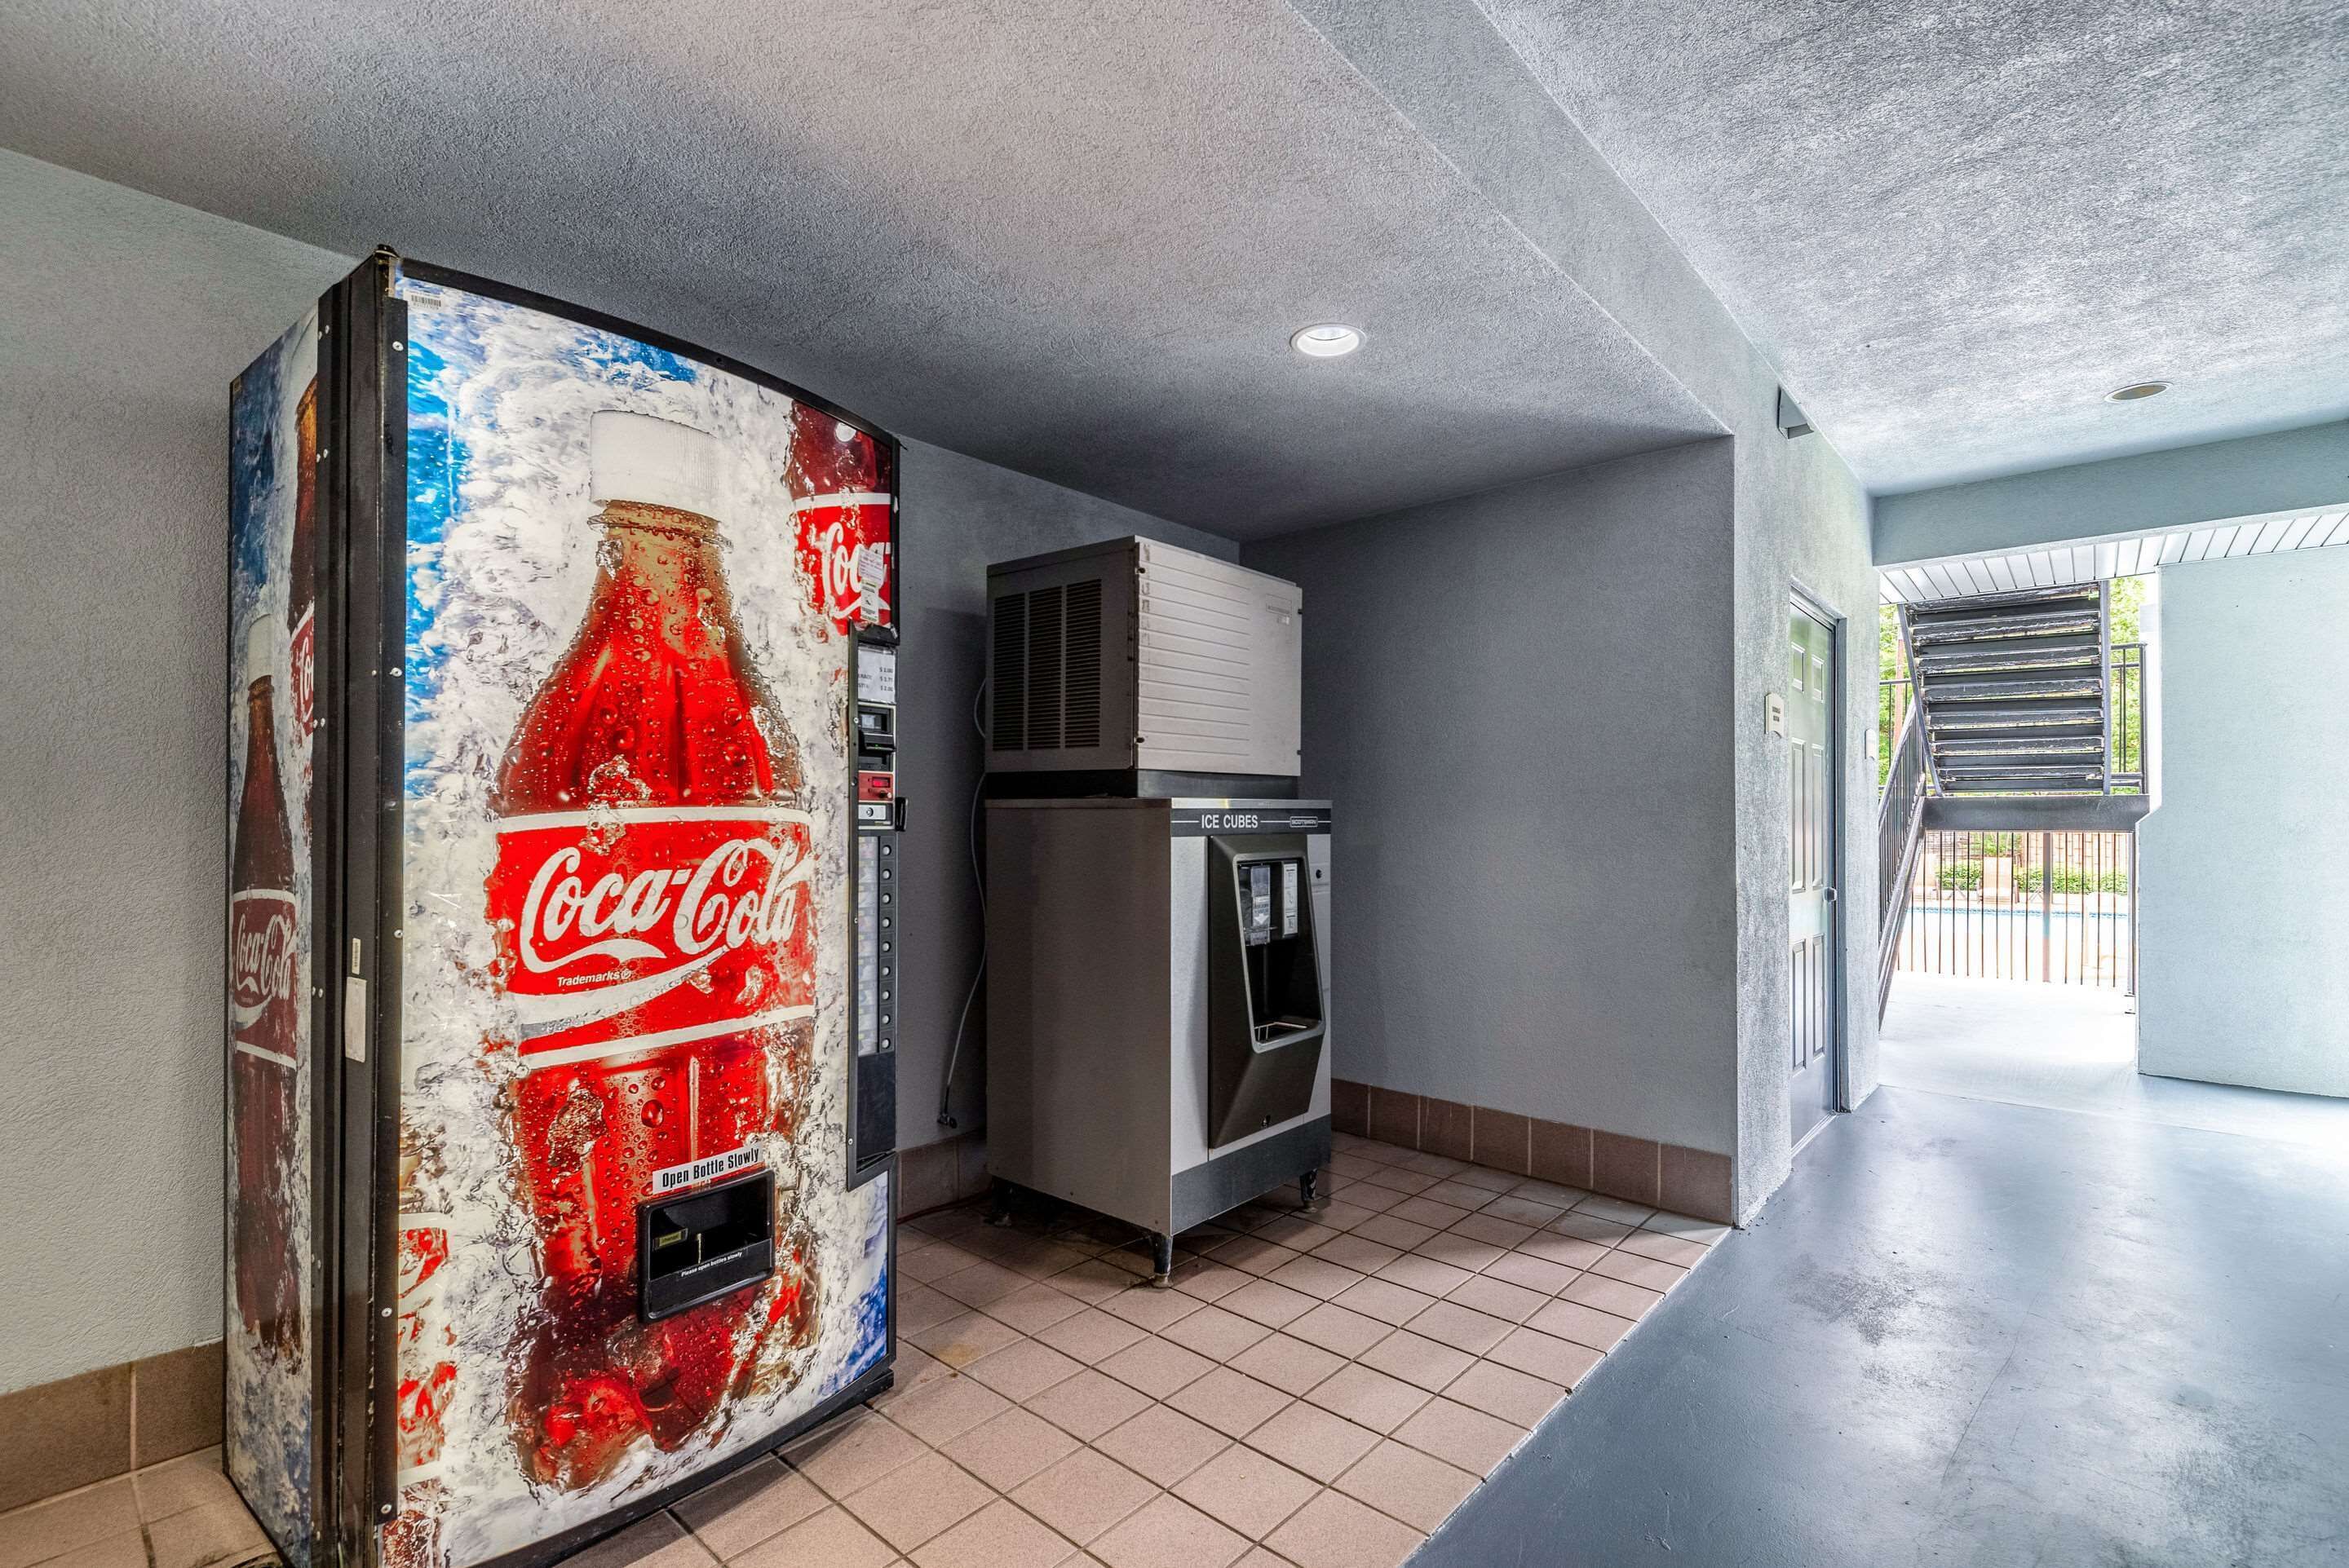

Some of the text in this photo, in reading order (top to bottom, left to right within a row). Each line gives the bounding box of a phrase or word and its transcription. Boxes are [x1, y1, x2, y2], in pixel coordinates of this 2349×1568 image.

[1201, 814, 1259, 829] ICE CUBES
[520, 838, 816, 972] Coca-Cola
[236, 913, 297, 1000] Coca-Cola
[662, 1147, 759, 1188] Open Bottle Slowly
[681, 1267, 698, 1278] Please
[698, 1262, 710, 1272] open
[728, 1252, 742, 1261] slowly
